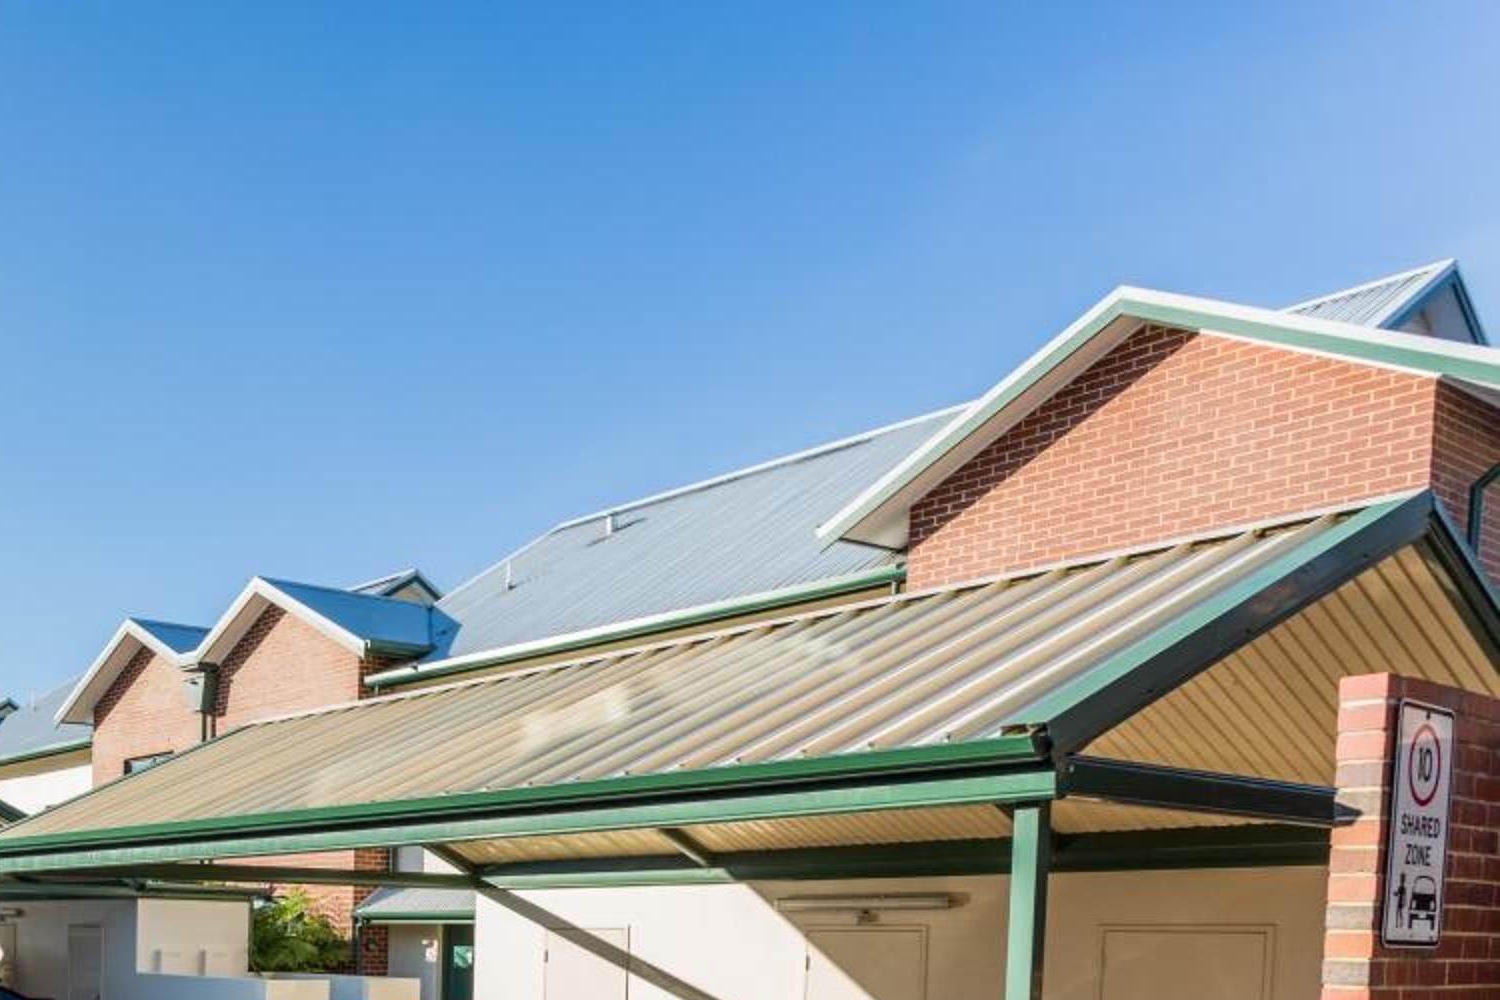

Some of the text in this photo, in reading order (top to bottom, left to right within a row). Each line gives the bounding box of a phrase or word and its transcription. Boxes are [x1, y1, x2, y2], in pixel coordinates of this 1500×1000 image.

[1417, 747, 1433, 782] 10
[1401, 813, 1441, 839] SHARED
[1404, 844, 1432, 867] ZONE
